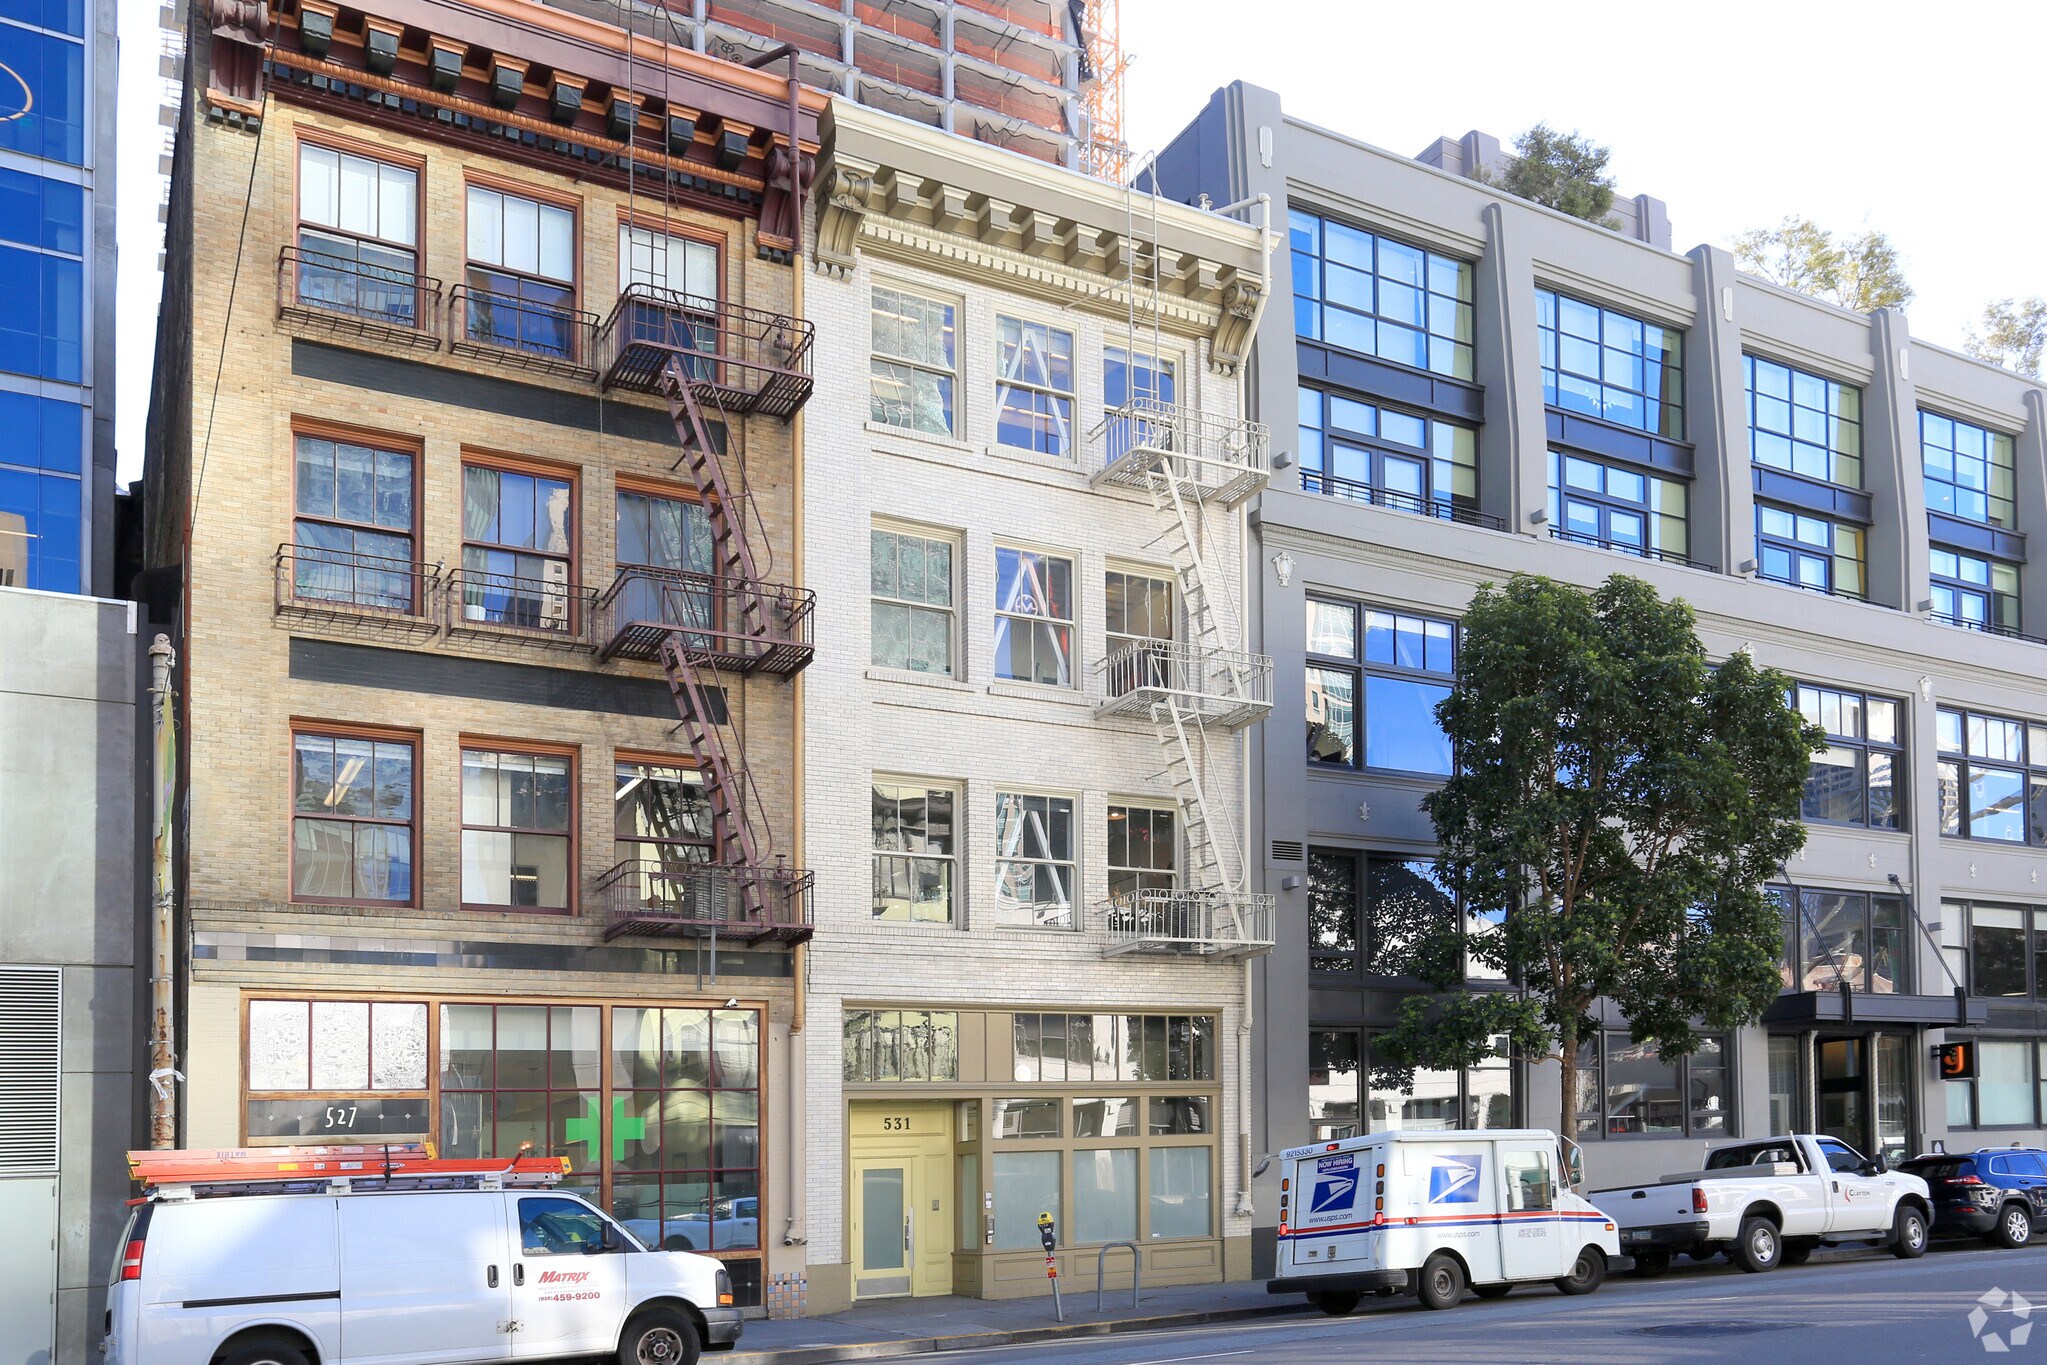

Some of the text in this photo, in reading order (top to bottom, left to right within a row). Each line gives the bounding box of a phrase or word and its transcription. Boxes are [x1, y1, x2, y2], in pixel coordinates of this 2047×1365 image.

[324, 1106, 358, 1128] 527
[883, 1117, 911, 1130] 531
[1285, 1147, 1313, 1158] 9215330
[1318, 1161, 1332, 1169] NOW
[1332, 1157, 1353, 1167] HIRING
[1309, 1213, 1353, 1223] www.usps.com
[1436, 1231, 1481, 1239] www.usps.com
